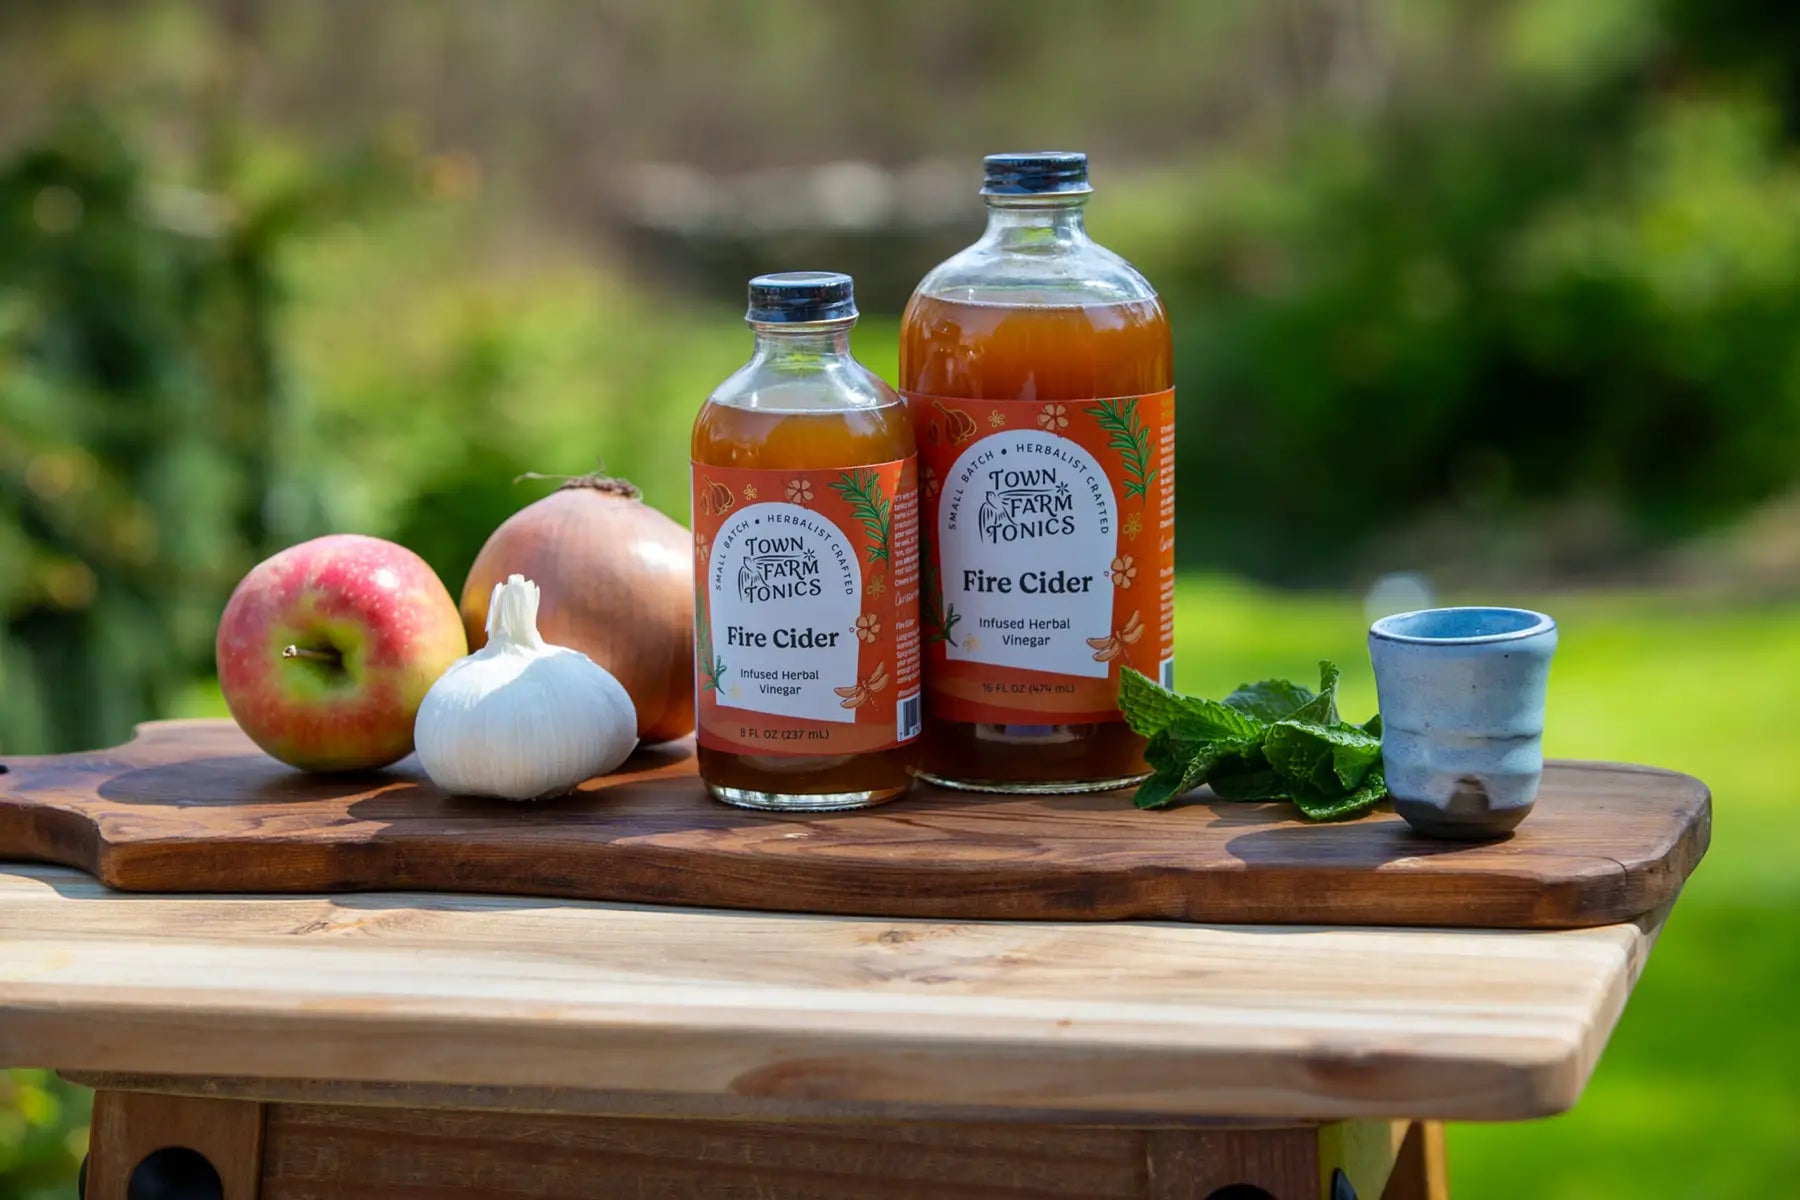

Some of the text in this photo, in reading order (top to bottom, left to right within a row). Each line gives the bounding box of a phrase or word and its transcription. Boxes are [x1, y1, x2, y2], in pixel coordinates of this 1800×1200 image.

[948, 443, 1109, 534] SMALL BATCH HERBALIST CRAFTED
[988, 468, 1056, 490] TOWN
[1010, 494, 1073, 518] FARM
[986, 515, 1075, 544] TONICS
[715, 514, 854, 595] SMALL BATCH HERBALIST CRAFTED
[744, 536, 804, 556] TOWN
[763, 559, 819, 580] FARM
[744, 578, 822, 604] TONICS
[963, 569, 1093, 594] Fire Cider
[979, 617, 1071, 629] Infused Herbal
[727, 626, 840, 649] Fire Cider
[1002, 635, 1051, 648] Vinegar
[740, 668, 819, 680] Infused Herbal
[759, 684, 802, 697] Vinegar
[1011, 684, 1026, 693] OZ
[740, 728, 746, 738] 8
[763, 729, 778, 739] OZ
[781, 729, 803, 740] (237
[808, 729, 830, 740] mL)
